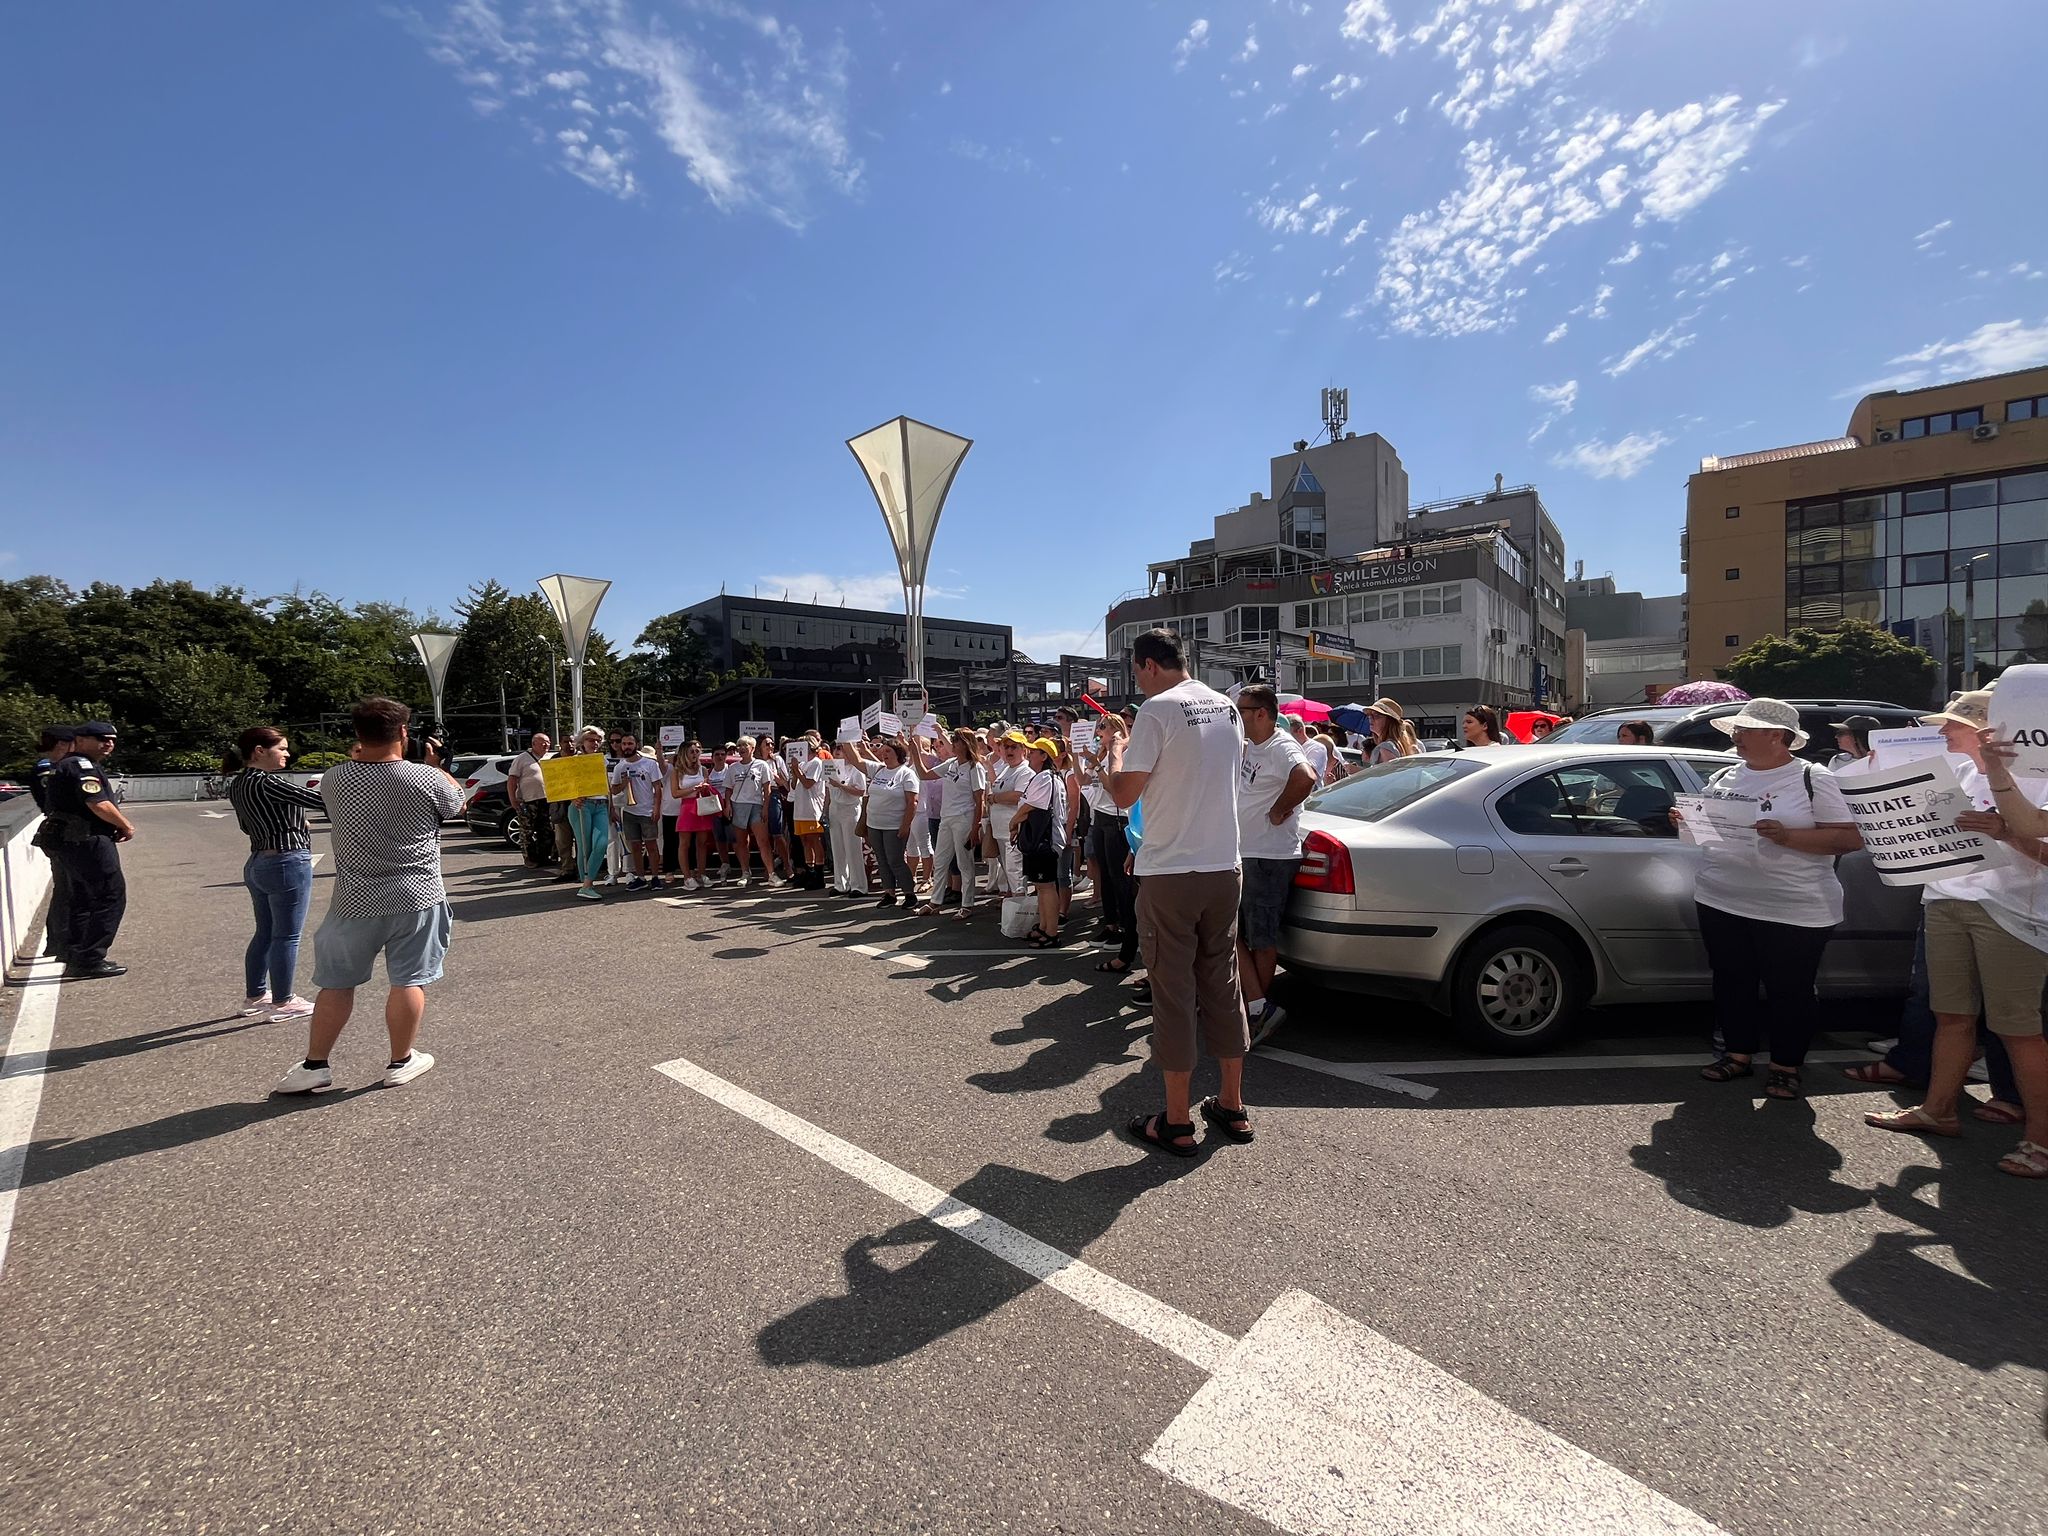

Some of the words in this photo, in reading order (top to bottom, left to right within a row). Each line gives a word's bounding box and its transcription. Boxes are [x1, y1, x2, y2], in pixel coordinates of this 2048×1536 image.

[1361, 573, 1421, 589] stomatologică
[1896, 812, 1941, 828] REALE
[1871, 836, 1897, 846] LEGII
[1898, 825, 1962, 844] PREVENTI
[1873, 849, 1919, 861] ORTARE
[1919, 837, 1984, 857] REALISTE
